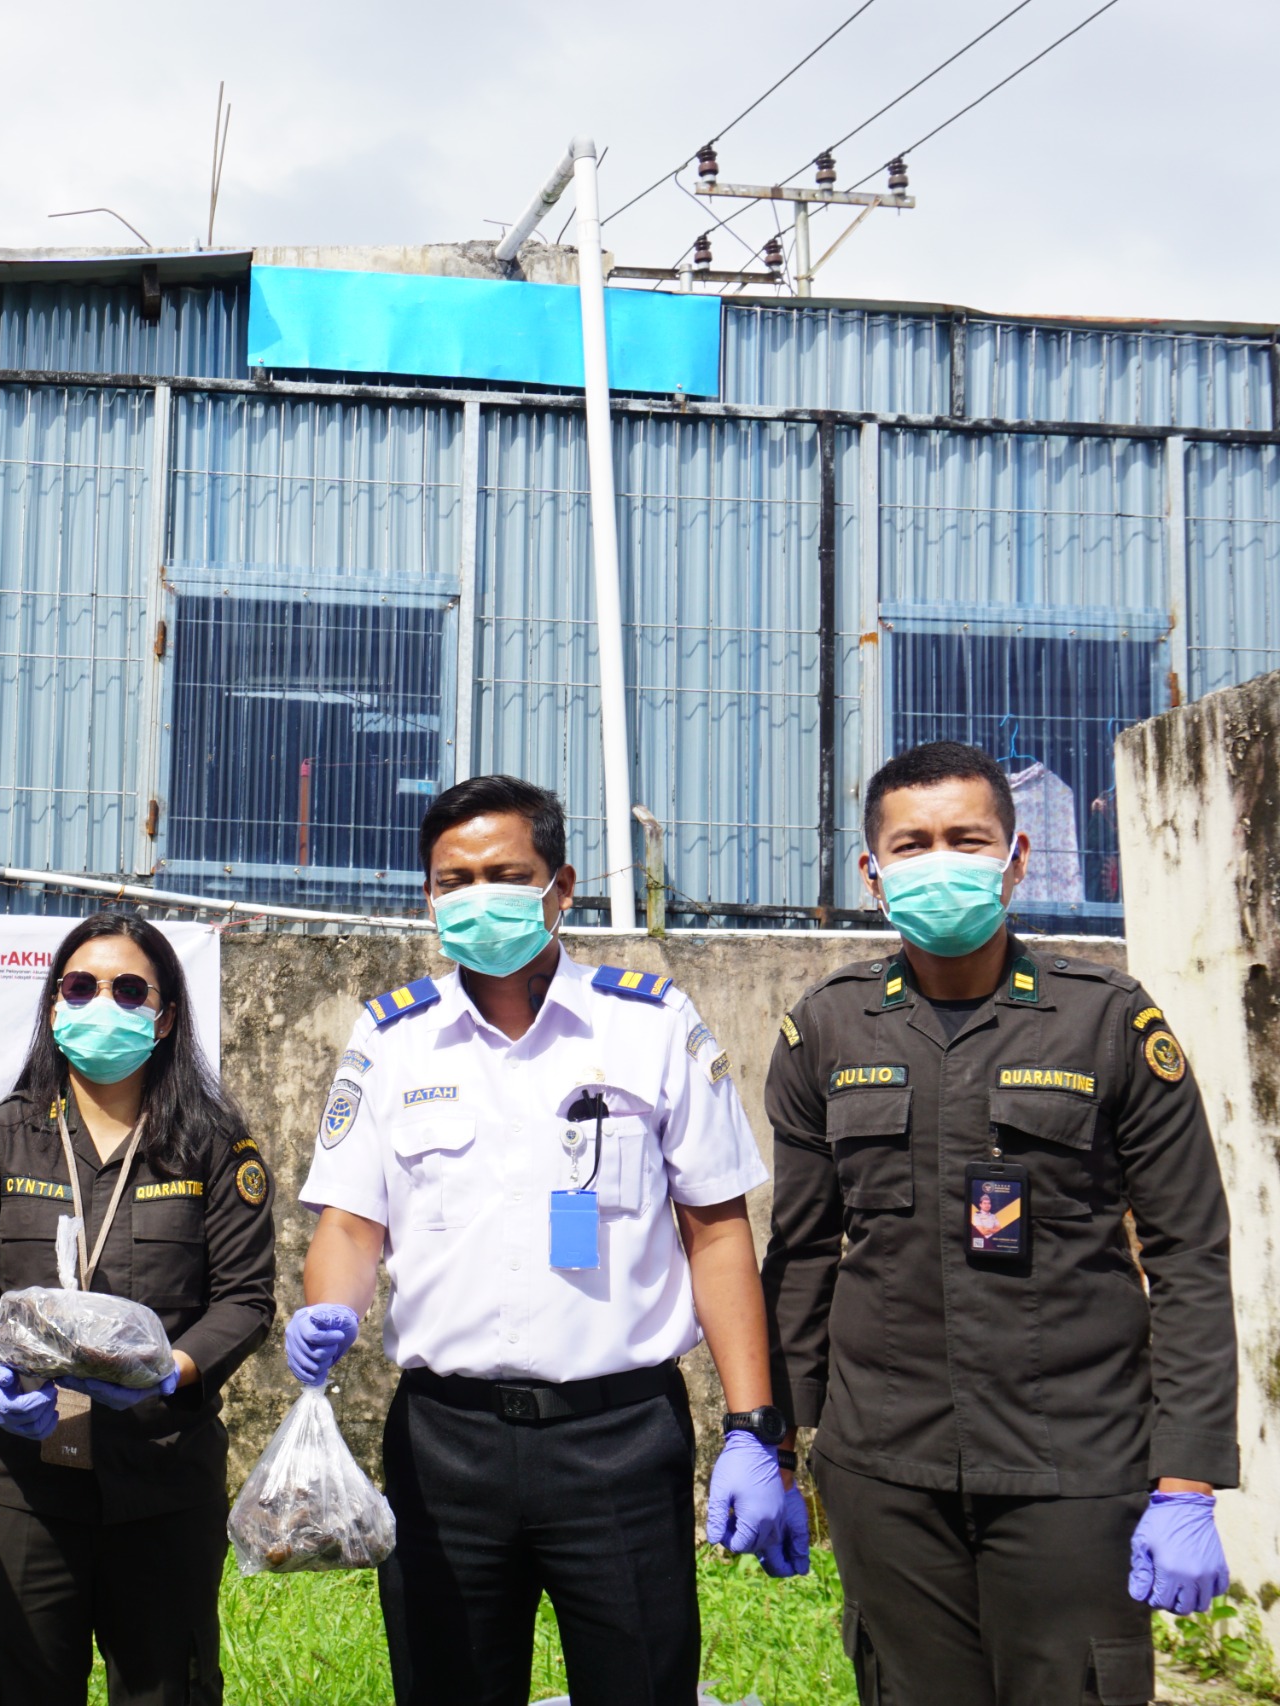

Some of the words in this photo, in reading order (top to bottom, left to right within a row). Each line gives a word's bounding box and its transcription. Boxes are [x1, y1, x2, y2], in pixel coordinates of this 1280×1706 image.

[835, 1067, 893, 1087] JULIO
[1000, 1070, 1095, 1093] QUARANTINE
[406, 1087, 454, 1103] FATAH
[6, 1178, 65, 1198] CYNTIA
[136, 1181, 203, 1199] QUARANTINE
